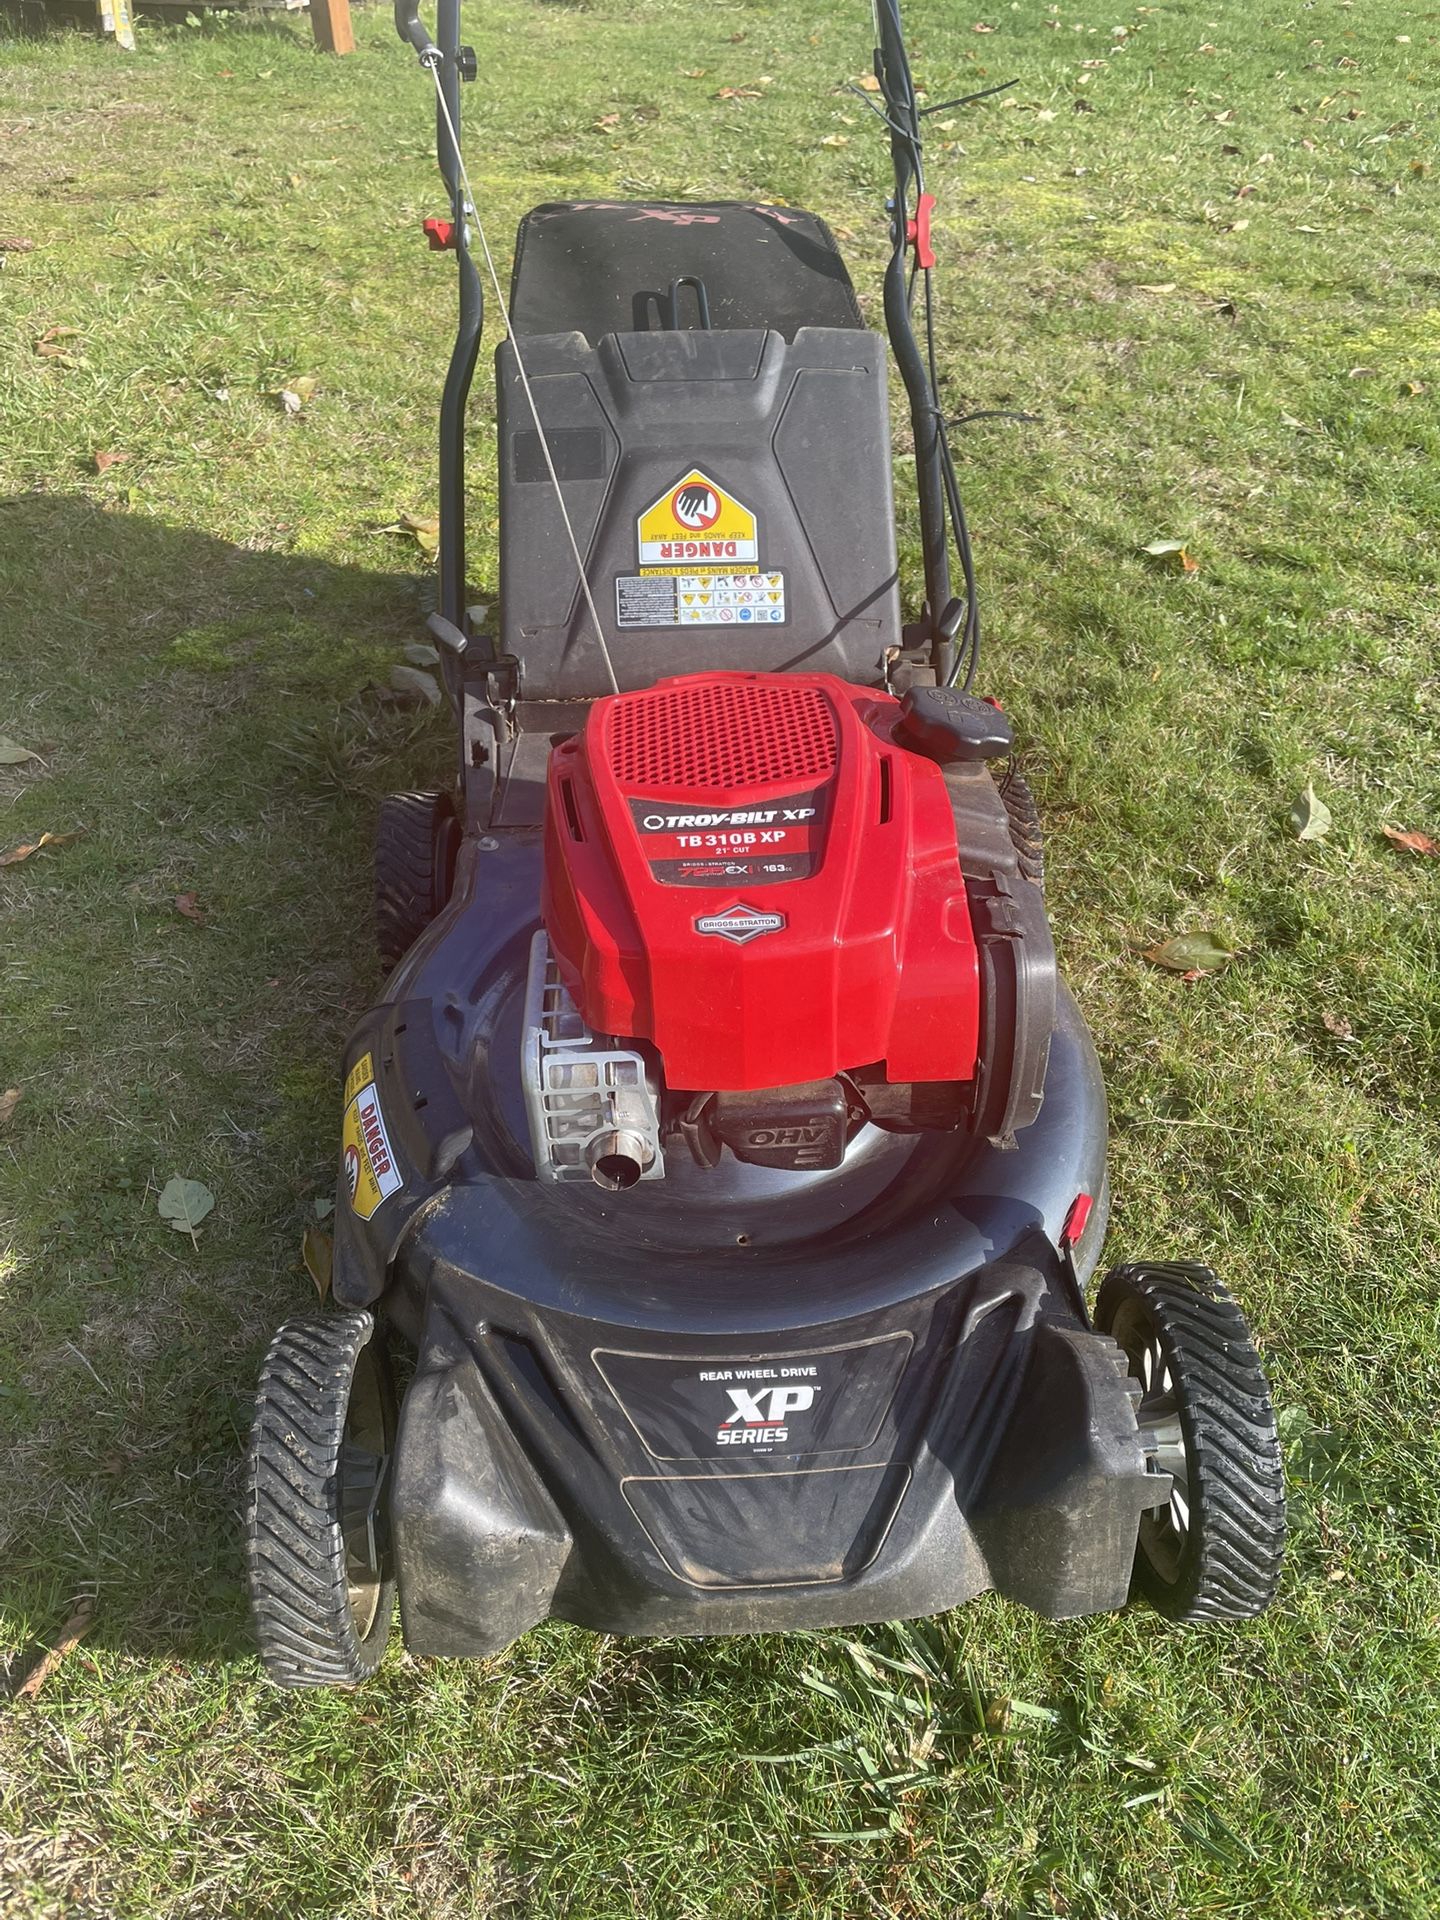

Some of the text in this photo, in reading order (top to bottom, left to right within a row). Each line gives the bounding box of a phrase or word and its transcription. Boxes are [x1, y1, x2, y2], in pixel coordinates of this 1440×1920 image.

[660, 541, 737, 558] DANGER
[642, 568, 673, 576] DISTANCE
[707, 566, 728, 575] MAINS
[666, 808, 816, 828] TROY-BILT XP
[676, 831, 786, 847] TB 310B XP
[733, 846, 750, 854] CUT
[360, 1103, 392, 1179] DANGER
[748, 1127, 828, 1145] OHV
[699, 1367, 817, 1381] REAR WHEEL DRIVE
[716, 1427, 788, 1445] SERIES
